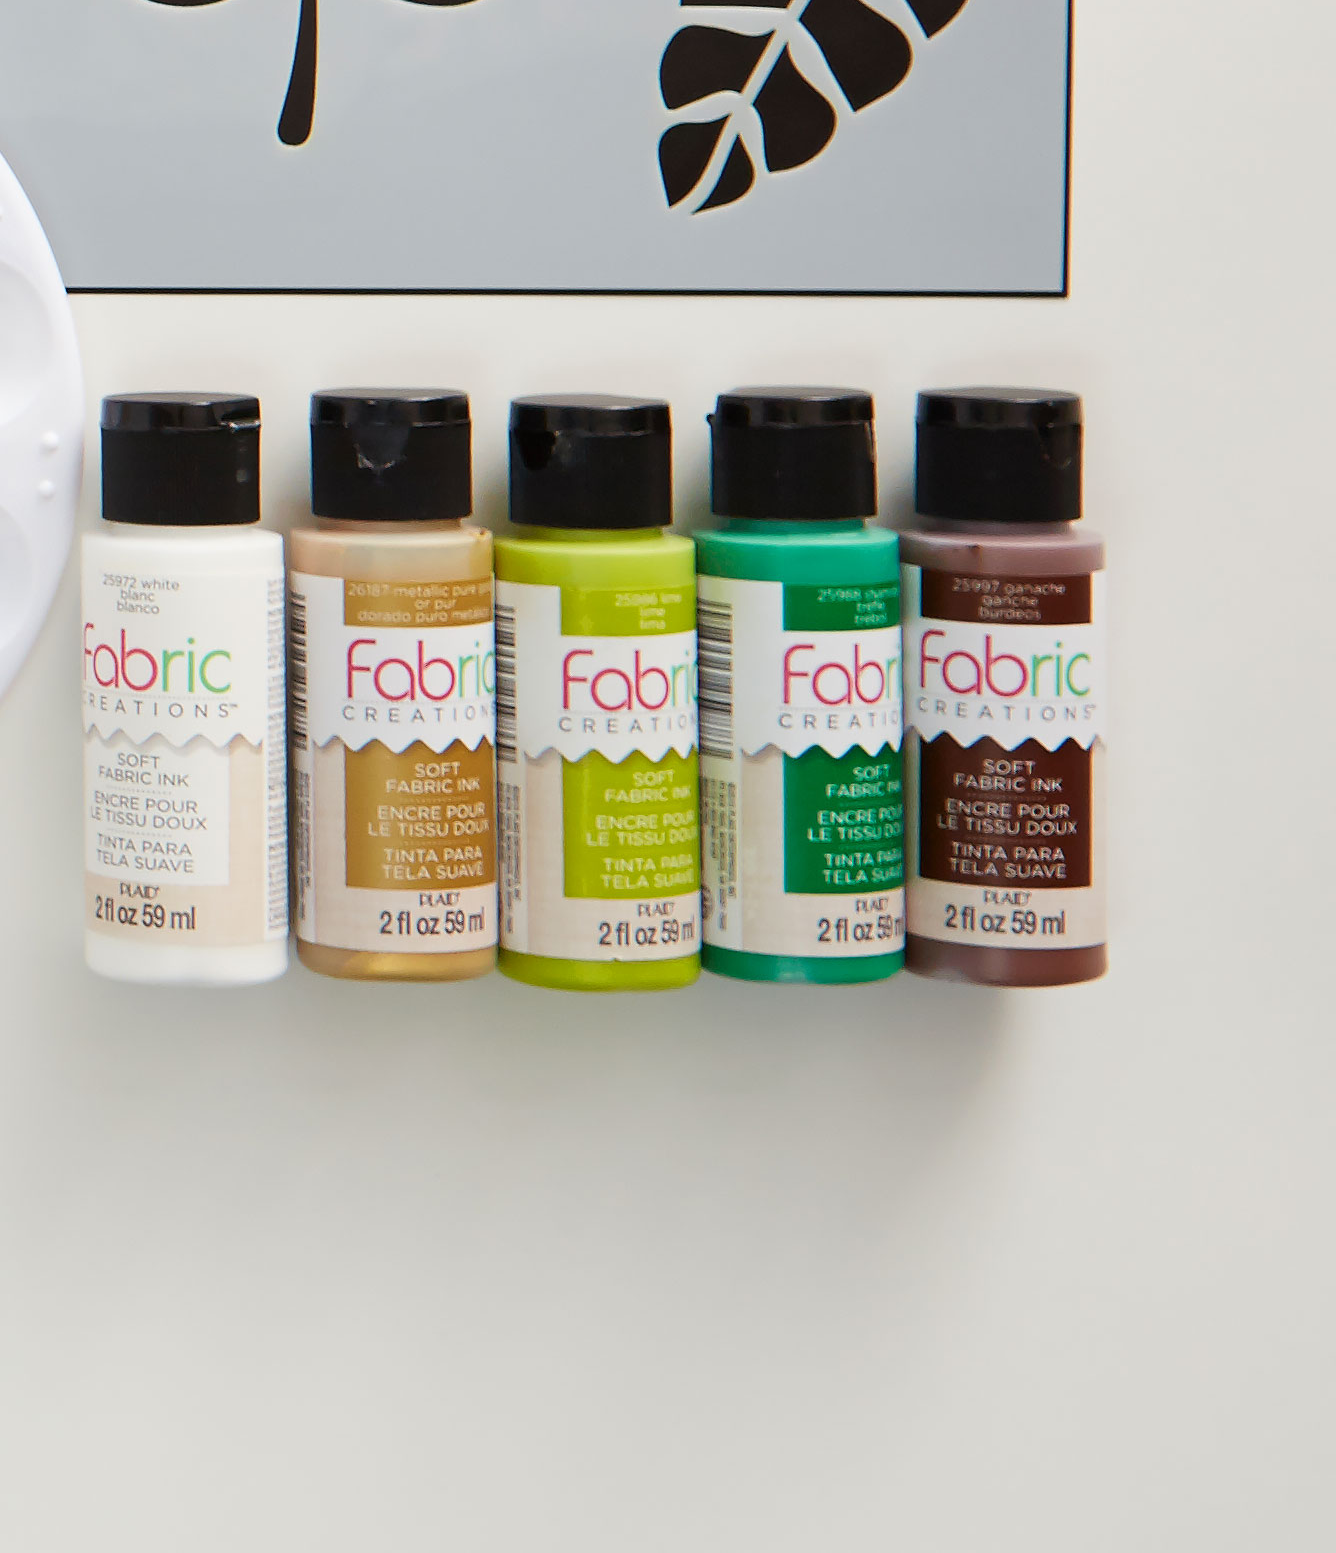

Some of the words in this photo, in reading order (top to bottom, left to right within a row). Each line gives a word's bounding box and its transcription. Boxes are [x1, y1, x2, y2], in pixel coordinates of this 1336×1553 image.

[141, 578, 180, 591] white
[1003, 583, 1066, 597] ganache
[120, 589, 155, 602] blanc
[116, 600, 160, 614] blanco
[117, 752, 160, 769] SOFT
[983, 759, 1036, 775] SOFT
[98, 765, 152, 785] FABRIC
[158, 774, 189, 787] INK
[414, 762, 461, 778] SOFT
[633, 770, 675, 787] SOFT
[852, 764, 890, 781] SOFT
[386, 778, 453, 794] FABRIC
[457, 777, 480, 791] INK
[825, 781, 885, 797] FABRIC
[953, 773, 1025, 792] FABRIC
[1031, 777, 1063, 792] INK
[94, 791, 139, 810] ENCRE
[145, 798, 198, 814] POUR
[604, 787, 668, 803] FABRIC
[378, 805, 441, 821] ENCRE
[446, 802, 485, 819] POUR
[817, 809, 877, 826] ENCRE
[945, 798, 1012, 817] ENCRE
[1018, 803, 1070, 820] POUR
[91, 806, 101, 820] LE
[105, 809, 146, 828] TISSU
[153, 816, 207, 830] DOUX
[596, 814, 658, 830] ENCRE
[936, 814, 958, 830] LE
[964, 817, 1021, 835] TISSU
[1026, 820, 1078, 836] DOUX
[368, 822, 392, 837] LE
[397, 822, 449, 838] TISSU
[807, 828, 832, 843] LE
[837, 826, 882, 841] TISSU
[97, 832, 136, 852] TINTA
[142, 841, 192, 856] PARA
[586, 833, 610, 847] LE
[617, 831, 665, 846] TISSU
[383, 847, 439, 864] TINTA
[444, 846, 483, 862] PARA
[824, 852, 874, 867] TINTA
[951, 841, 1007, 860] TINTA
[1014, 847, 1065, 861] PARA
[96, 849, 129, 867] TELA
[135, 856, 194, 873] SUAVE
[603, 857, 656, 873] TINTA
[950, 858, 999, 876] TELA
[1004, 863, 1067, 879] SUAVE
[382, 865, 431, 881] TELA
[436, 861, 484, 880] SUAVE
[822, 870, 868, 884] TELA
[601, 874, 649, 890] TELA
[95, 895, 103, 919] 2
[118, 907, 137, 926] oz
[142, 904, 165, 928] 59
[171, 906, 197, 930] ml
[380, 910, 392, 934] 2
[397, 910, 411, 934] fl
[417, 917, 440, 935] oz
[445, 910, 465, 934] 59
[469, 906, 485, 932] ml
[944, 904, 957, 928] 2
[962, 905, 975, 931] fl
[981, 914, 1007, 934] oz
[1012, 910, 1036, 935] 59
[1042, 910, 1066, 935] ml
[599, 921, 612, 945] 2
[616, 921, 630, 945] fl
[636, 927, 657, 945] oz
[662, 919, 679, 943] 59
[818, 917, 831, 942] 2
[836, 917, 849, 942] fl
[854, 923, 874, 941] oz
